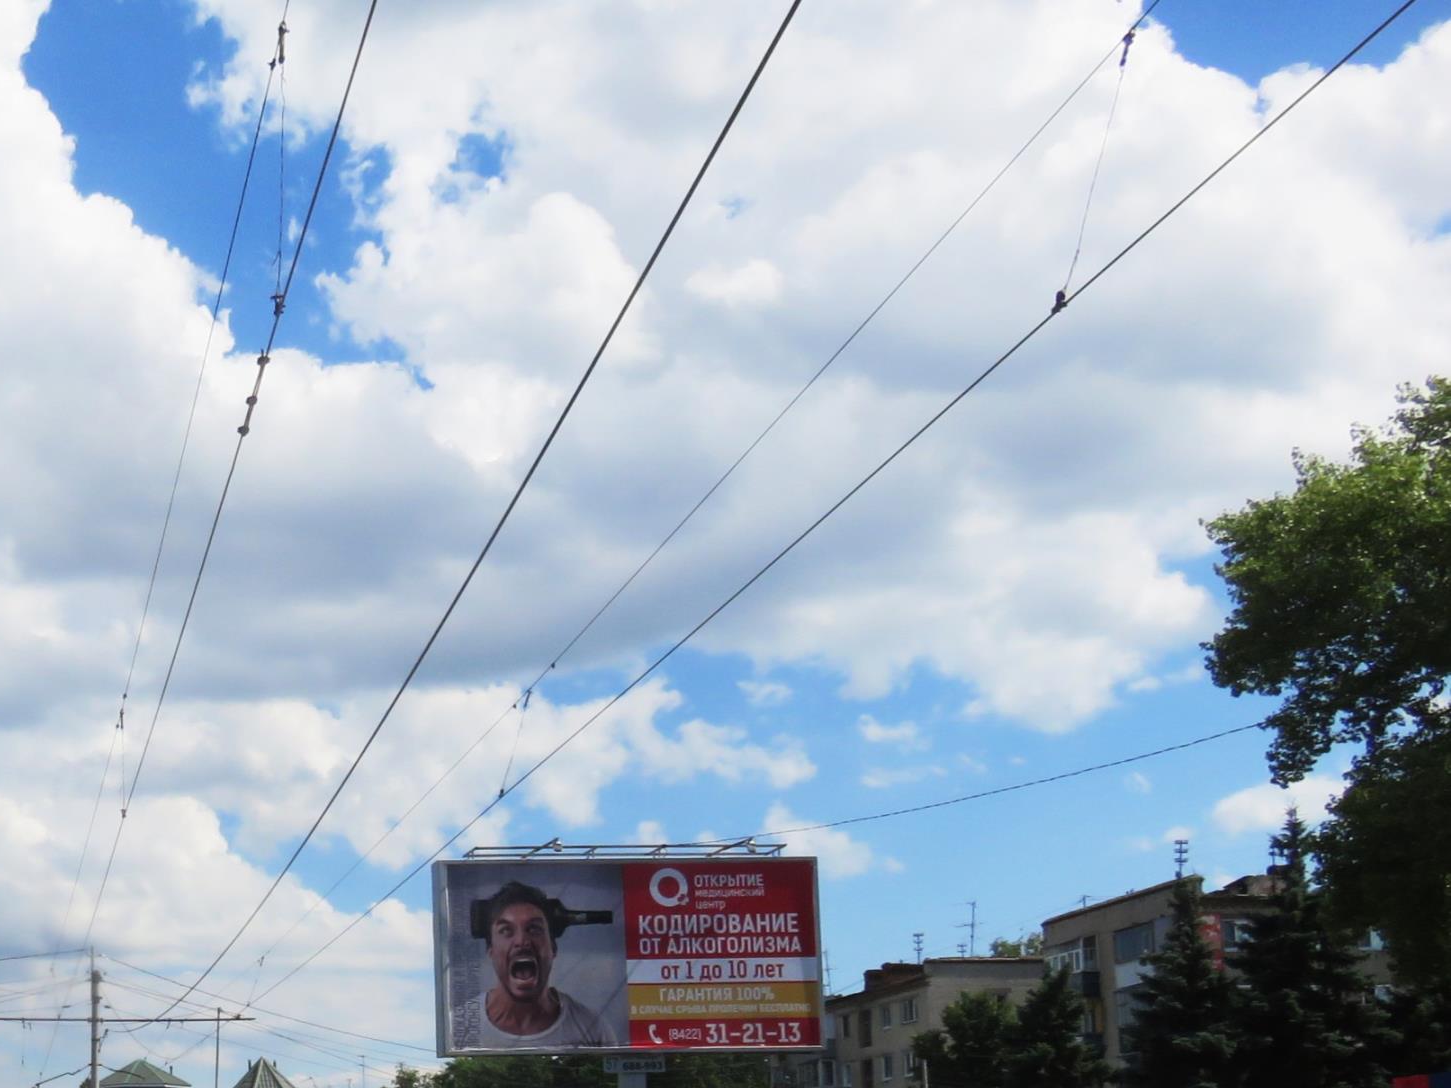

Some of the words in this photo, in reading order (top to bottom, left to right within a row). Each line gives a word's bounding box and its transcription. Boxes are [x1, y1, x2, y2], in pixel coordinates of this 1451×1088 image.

[694, 874, 764, 888] ОТКРЫТИЕ
[695, 899, 726, 910] центр
[638, 913, 799, 936] КОДИРОВАНИЕ
[639, 938, 661, 955] ОТ
[666, 936, 802, 955] АЛКОГОЛИЗМА
[660, 965, 680, 980] от
[685, 961, 694, 979] 1
[699, 964, 722, 982] до
[728, 960, 747, 979] 10
[753, 964, 785, 979] лет
[659, 988, 732, 1002] ГАРАНТИЯ
[738, 986, 775, 1001] 100%
[668, 1027, 701, 1041] (8422)
[705, 1022, 802, 1044] 31-21-13
